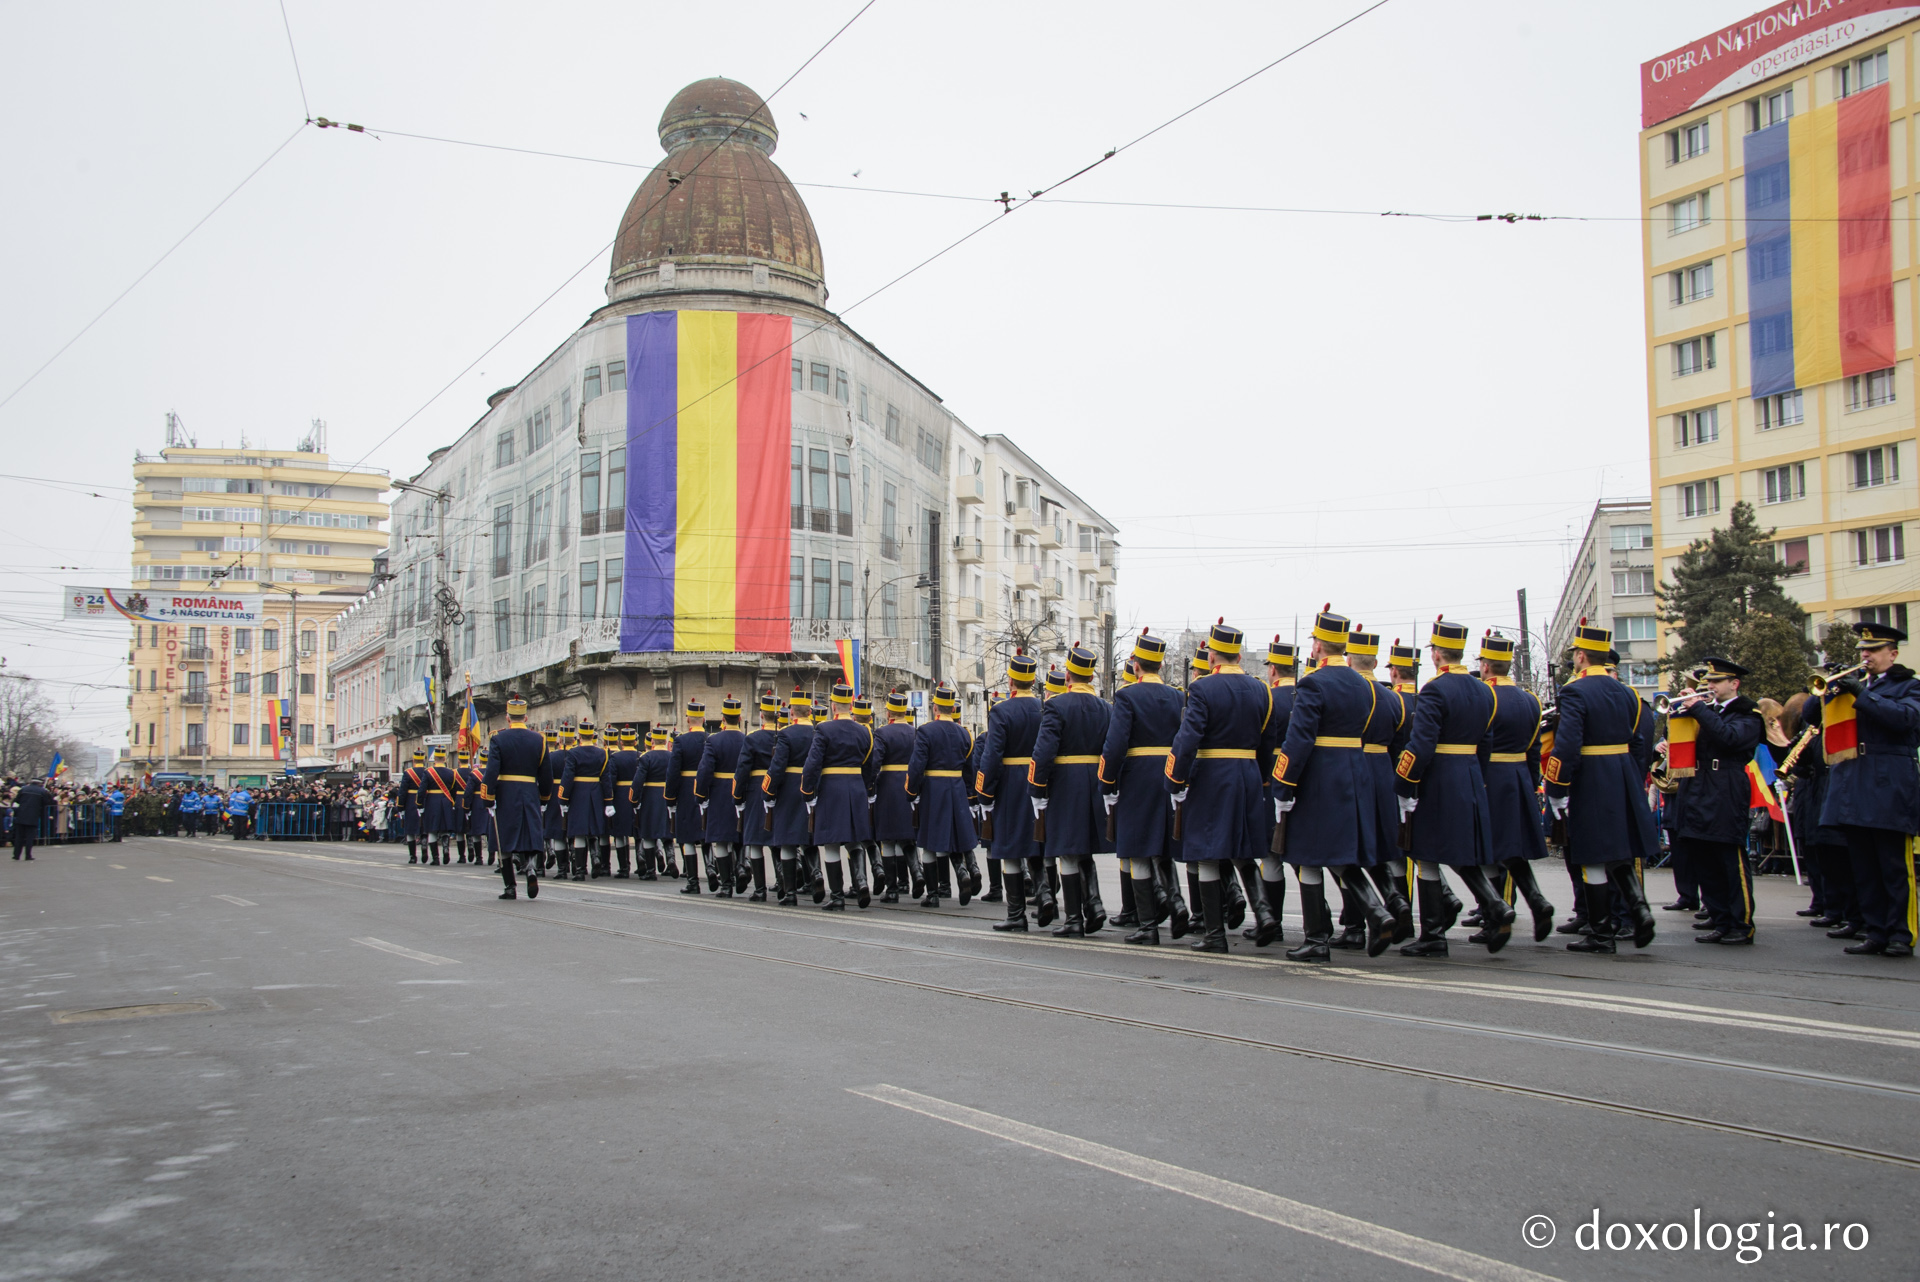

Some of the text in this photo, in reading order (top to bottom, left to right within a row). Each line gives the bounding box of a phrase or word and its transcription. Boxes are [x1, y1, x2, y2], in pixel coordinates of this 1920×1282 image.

[1651, 44, 1712, 83] OPERA
[1751, 23, 1856, 77] operaiasi.ro
[87, 595, 105, 604] 24
[172, 596, 244, 611] ROMÂNIA
[180, 608, 219, 618] NĂSCUT
[236, 613, 255, 621] IAȘI
[166, 626, 177, 693] HOTEL
[220, 626, 229, 700] CONTINENTAL
